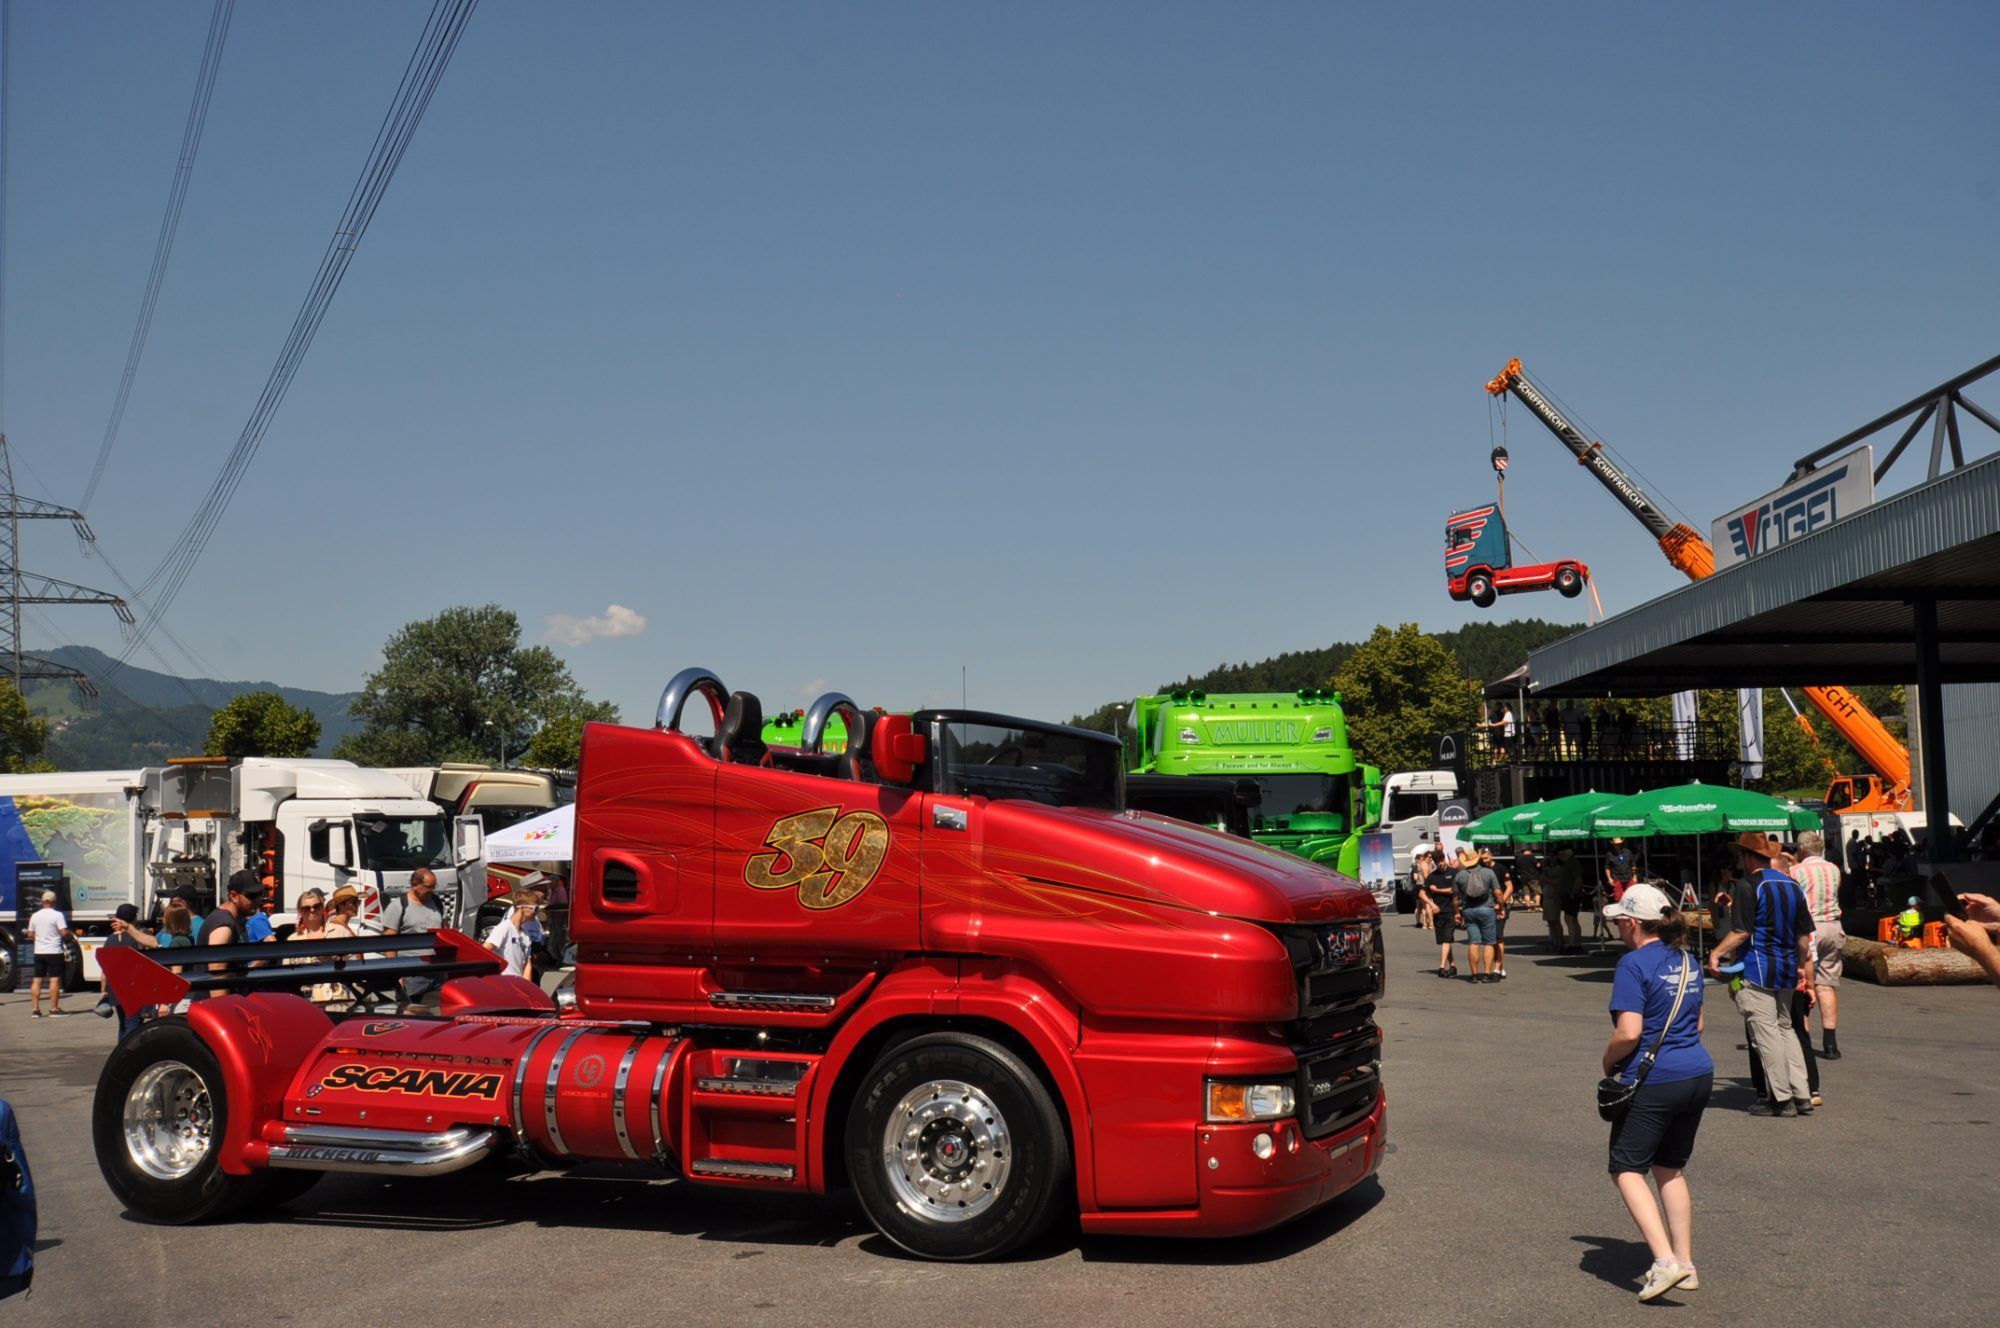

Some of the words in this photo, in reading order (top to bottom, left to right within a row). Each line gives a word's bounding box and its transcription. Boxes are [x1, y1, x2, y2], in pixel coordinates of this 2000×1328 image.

[1517, 381, 1567, 431] SCHEFFKNECHT
[1593, 456, 1645, 509] SCHEFFKNECHT
[322, 1064, 503, 1100] SCANIA
[285, 1148, 381, 1164] MICHELIN
